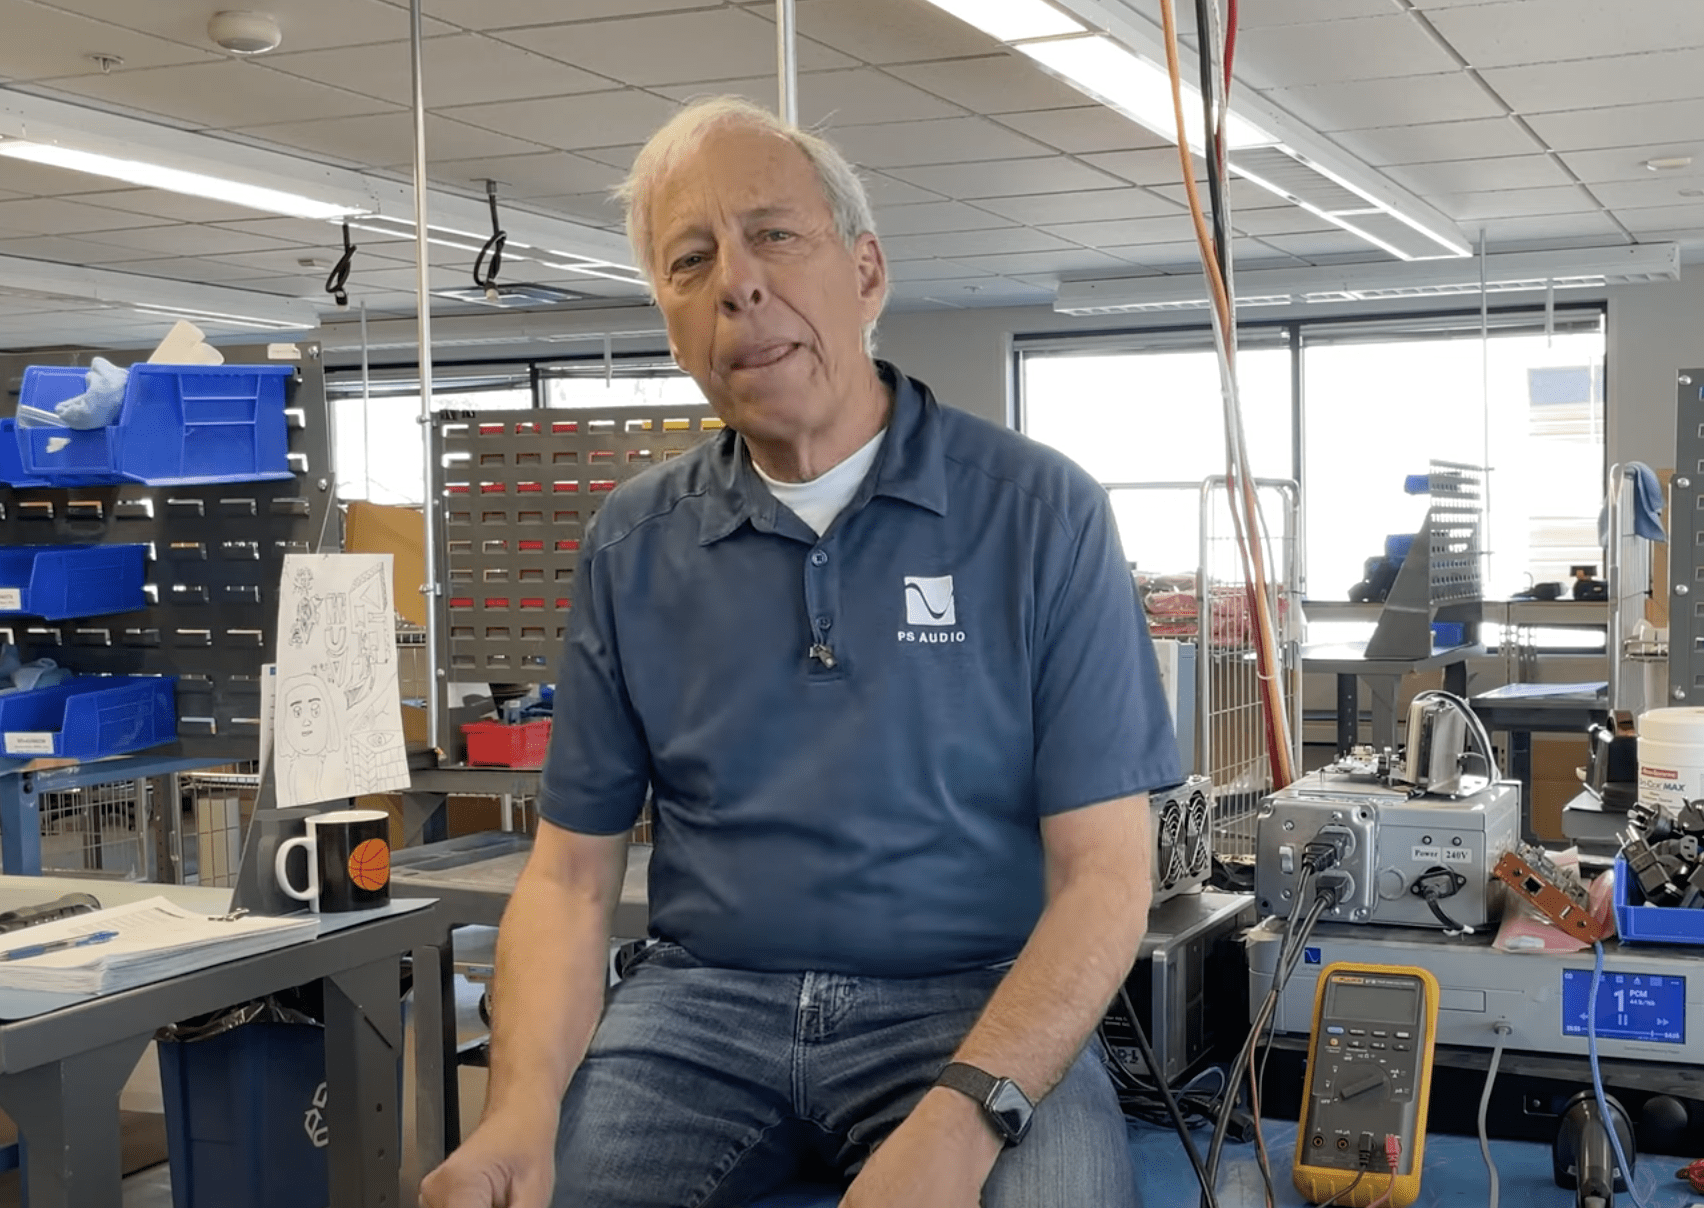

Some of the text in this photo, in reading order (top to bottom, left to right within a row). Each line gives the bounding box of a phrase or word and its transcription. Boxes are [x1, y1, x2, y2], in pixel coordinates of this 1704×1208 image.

[897, 630, 966, 643] PS AUDIO
[1662, 782, 1686, 792] MAX
[1414, 849, 1438, 858] Power
[1446, 850, 1469, 860] 240V
[1629, 989, 1648, 998] PCM
[1613, 989, 1625, 1012] 1
